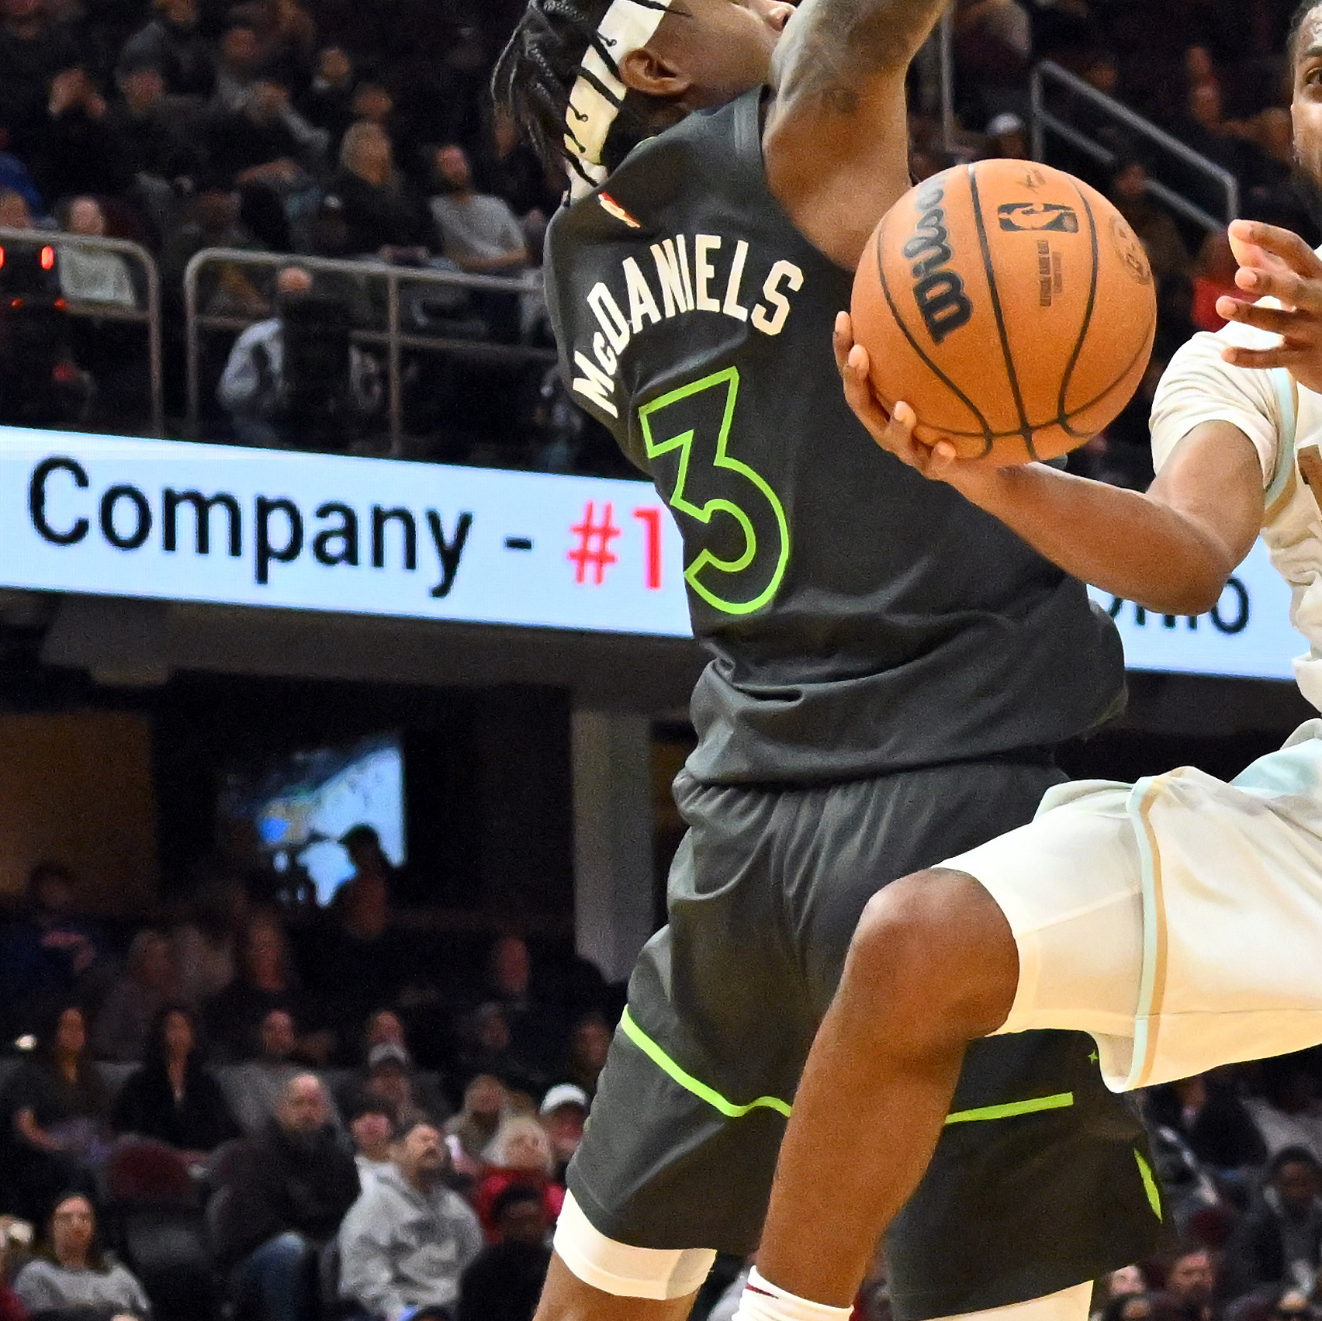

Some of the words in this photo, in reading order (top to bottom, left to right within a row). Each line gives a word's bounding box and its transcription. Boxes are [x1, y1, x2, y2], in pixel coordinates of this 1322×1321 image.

[573, 234, 804, 418] McDANIELS
[28, 456, 474, 598] Company
[567, 500, 664, 591] #1
[638, 366, 790, 615] 3
